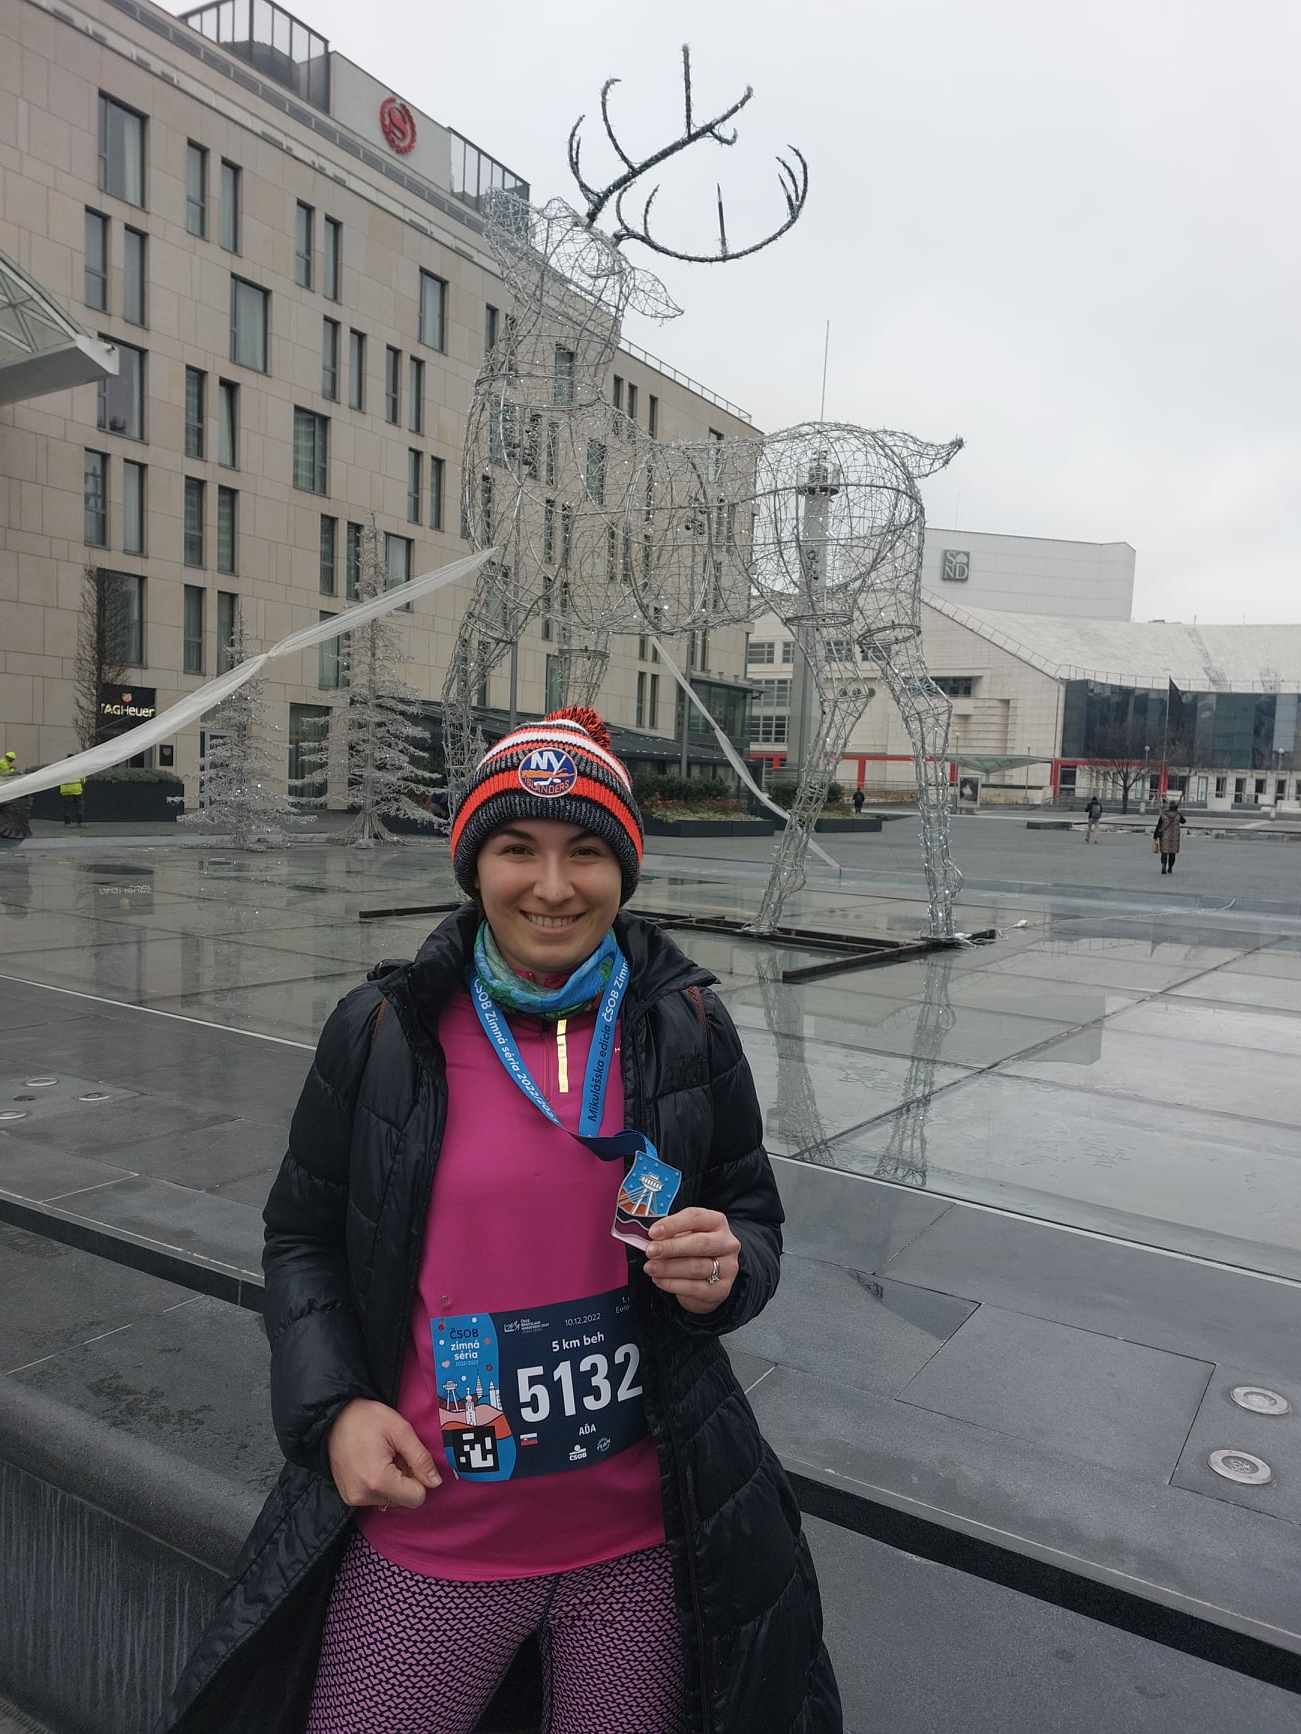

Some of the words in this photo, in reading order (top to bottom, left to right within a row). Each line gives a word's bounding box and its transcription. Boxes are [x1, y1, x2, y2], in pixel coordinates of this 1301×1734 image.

[530, 751, 567, 775] NY
[524, 778, 570, 794] ISLANDERS
[602, 990, 619, 1022] ČSOB
[484, 1010, 509, 1045] Zimná
[564, 1312, 601, 1327] 10.12.2022
[449, 1328, 479, 1340] ČSOB
[551, 1340, 560, 1352] 5
[562, 1338, 580, 1350] km
[583, 1331, 605, 1346] beh
[450, 1340, 480, 1351] zimná
[454, 1350, 478, 1360] séria
[517, 1343, 643, 1423] 5132
